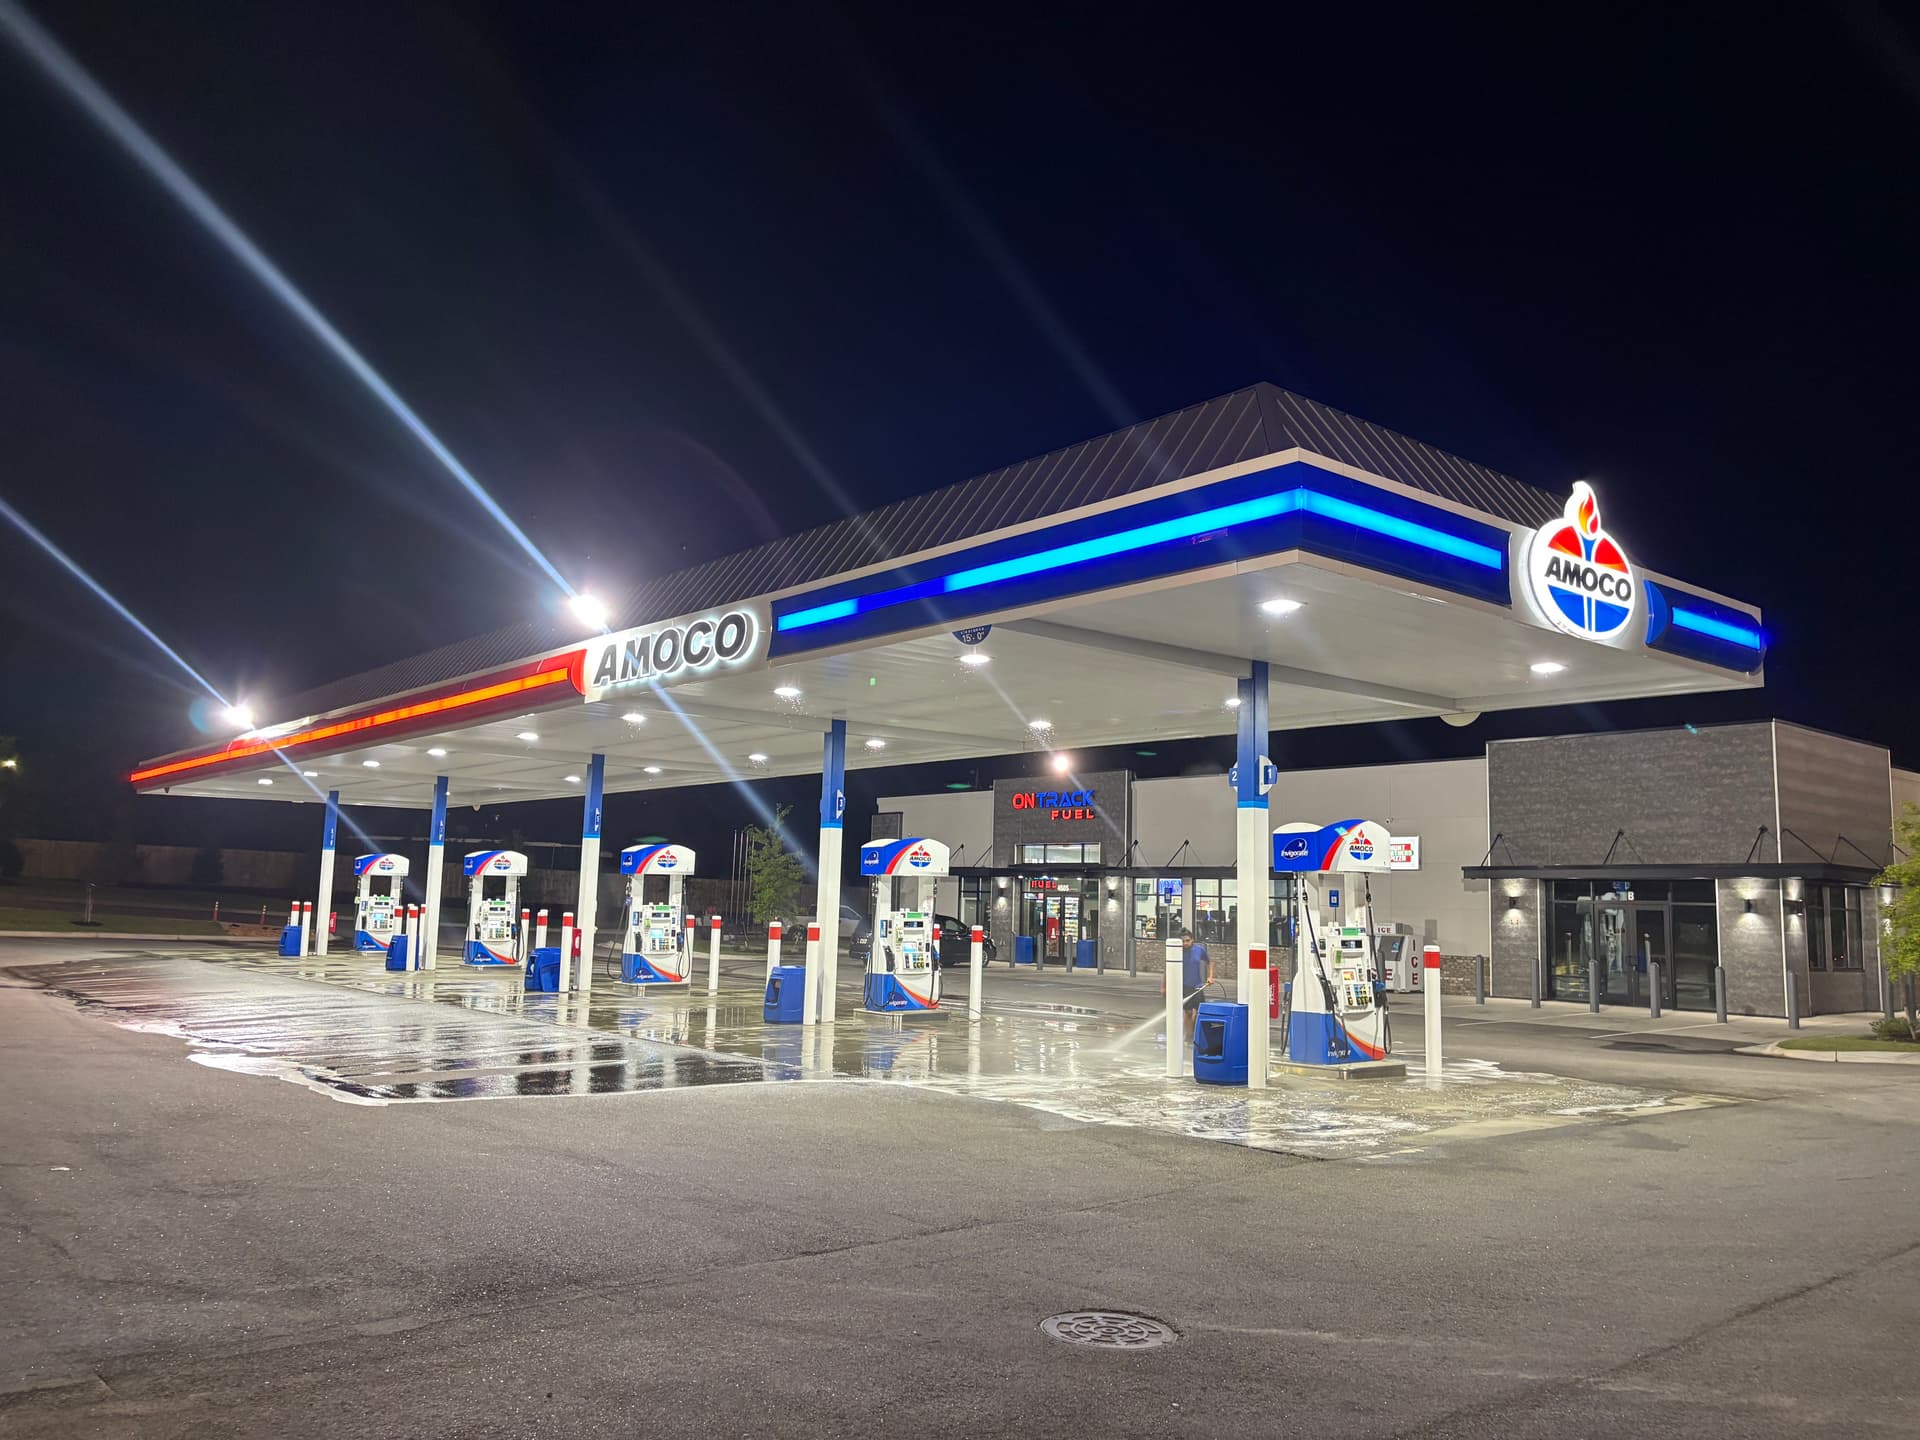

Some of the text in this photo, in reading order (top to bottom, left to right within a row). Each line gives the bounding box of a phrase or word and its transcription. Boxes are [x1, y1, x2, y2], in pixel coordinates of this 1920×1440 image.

[1545, 556, 1631, 601] AMOCO
[592, 611, 752, 687] AMOCO
[1231, 770, 1238, 782] 2
[1267, 768, 1272, 779] 1
[1051, 808, 1095, 820] FUEL
[1349, 845, 1374, 853] AMOCO
[1627, 891, 1635, 901] B
[1411, 939, 1419, 986] ICE
